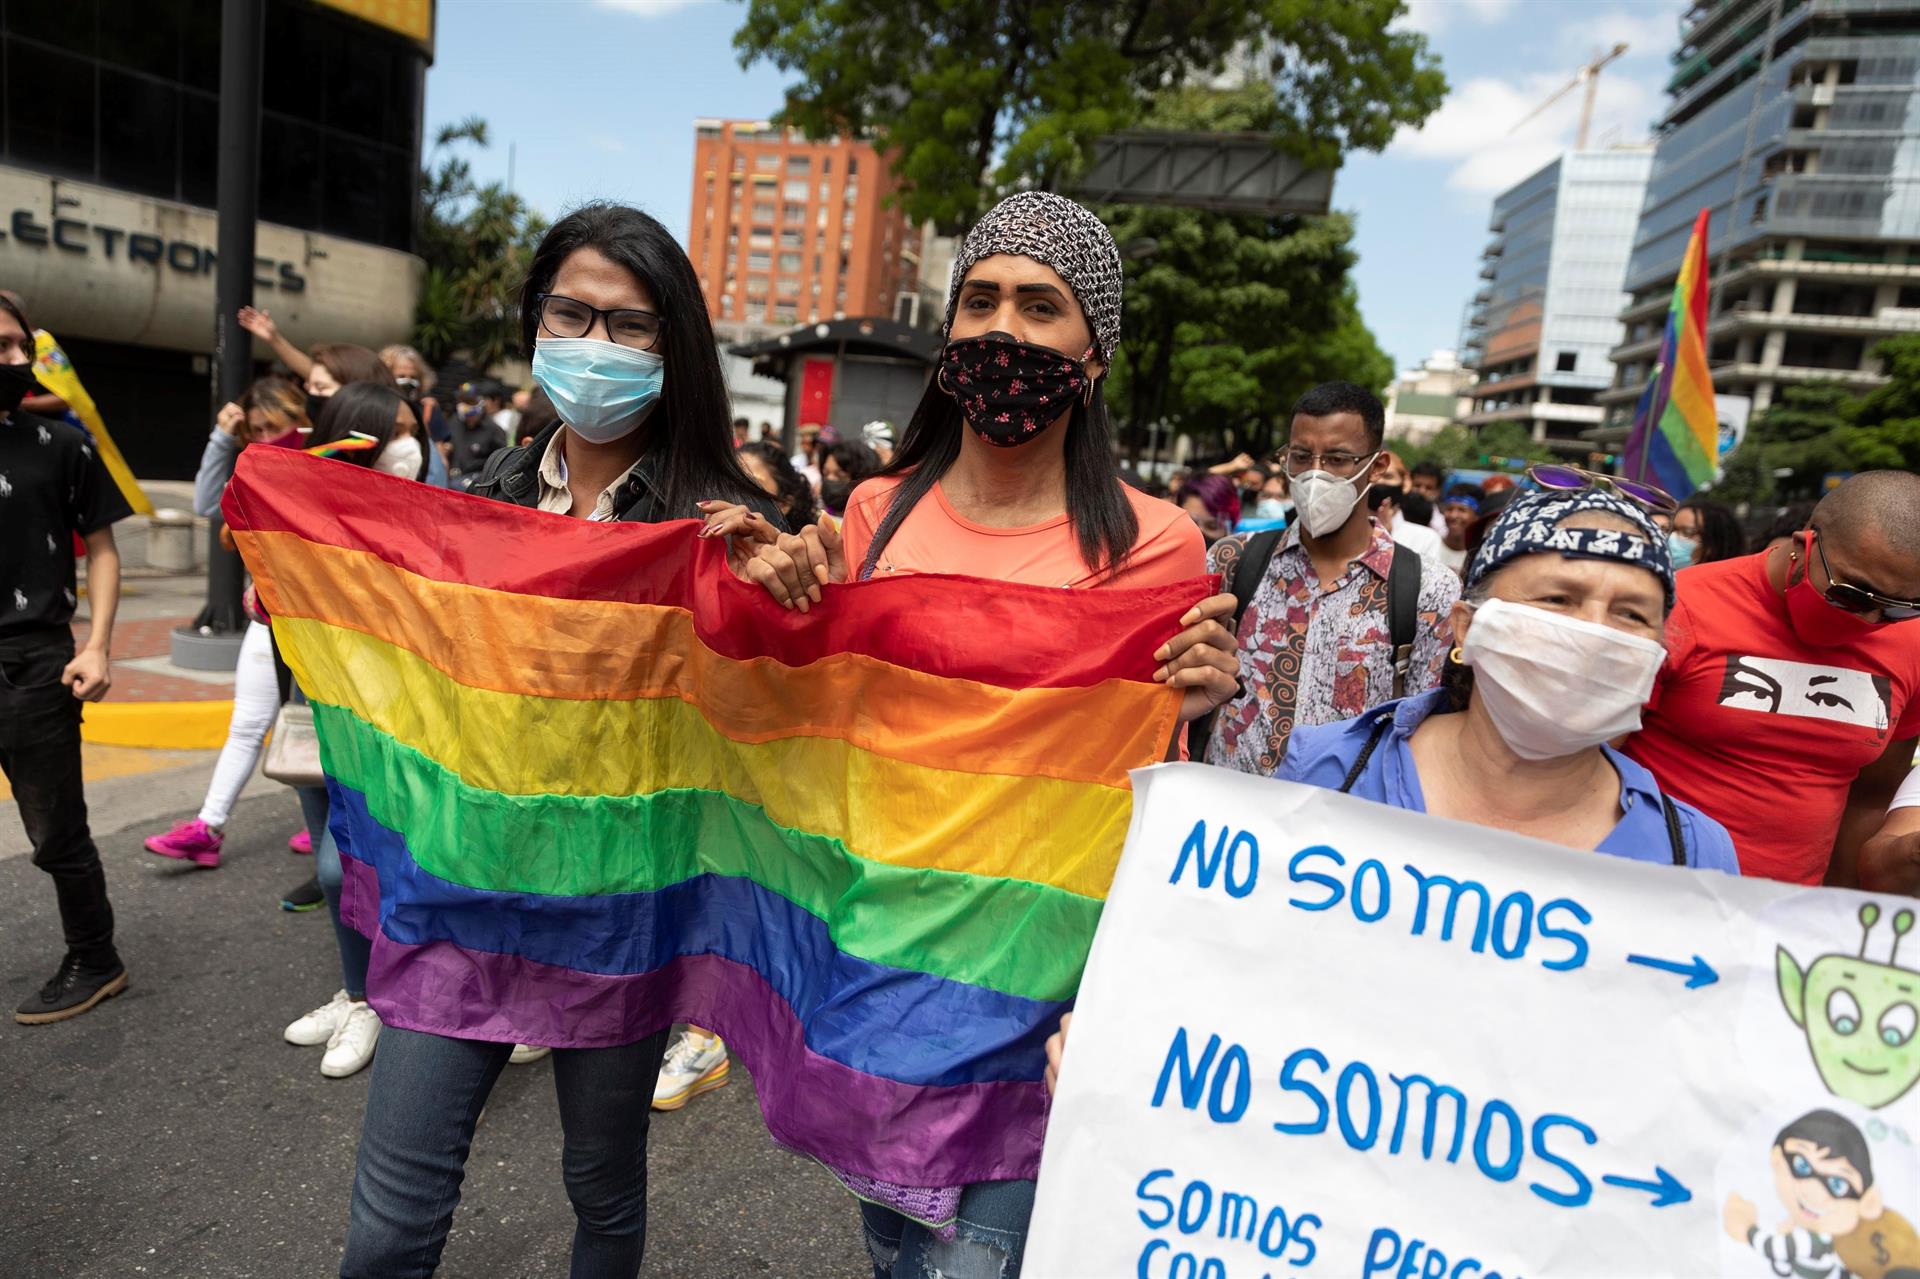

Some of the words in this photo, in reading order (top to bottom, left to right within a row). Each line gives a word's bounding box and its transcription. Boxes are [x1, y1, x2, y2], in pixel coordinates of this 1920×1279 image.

[1169, 819, 1259, 899] NO
[1288, 845, 1592, 972] SOMOS
[1151, 1027, 1251, 1124] NO
[1273, 1047, 1598, 1208] SOMOS
[1136, 1169, 1322, 1267] SOMOS
